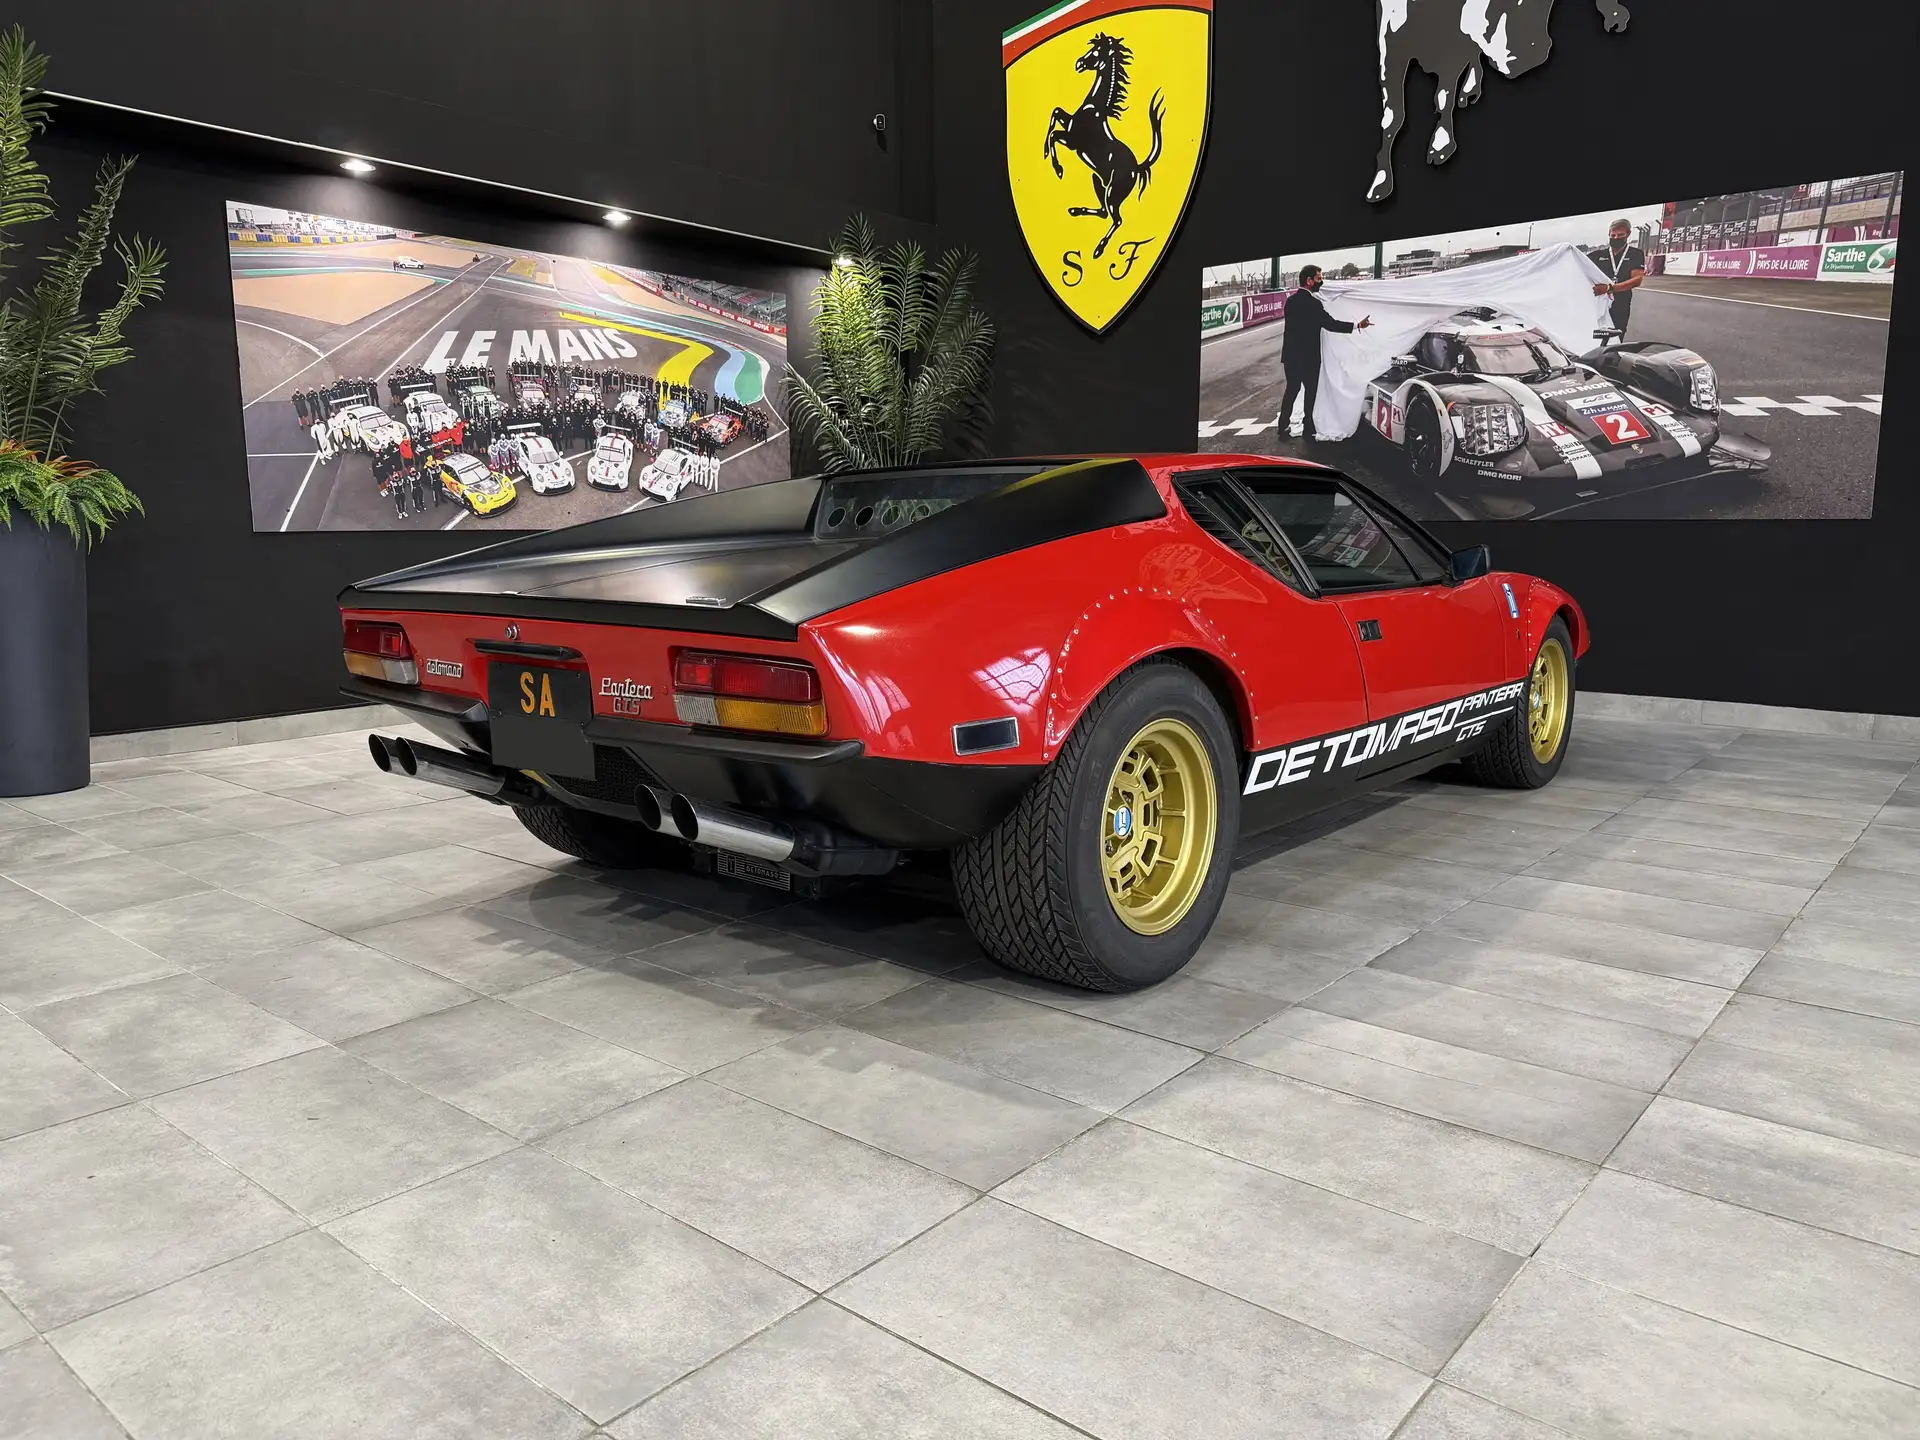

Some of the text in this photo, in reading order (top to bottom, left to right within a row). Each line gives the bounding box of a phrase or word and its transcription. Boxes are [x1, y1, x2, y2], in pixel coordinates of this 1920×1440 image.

[1756, 260, 1809, 270] PAYS DE LA LOIRE
[1826, 247, 1866, 262] Sarthe
[1061, 250, 1083, 287] S
[422, 329, 638, 374] LE MANS
[1540, 387, 1578, 400] DMG
[1380, 406, 1388, 434] 2
[1606, 414, 1639, 440] 2
[1453, 455, 1495, 468] SCHAEFFLER
[1477, 469, 1522, 481] DMG MORI
[519, 671, 556, 717] SA
[1460, 682, 1525, 714] PANTERA
[1455, 720, 1488, 743] GTS
